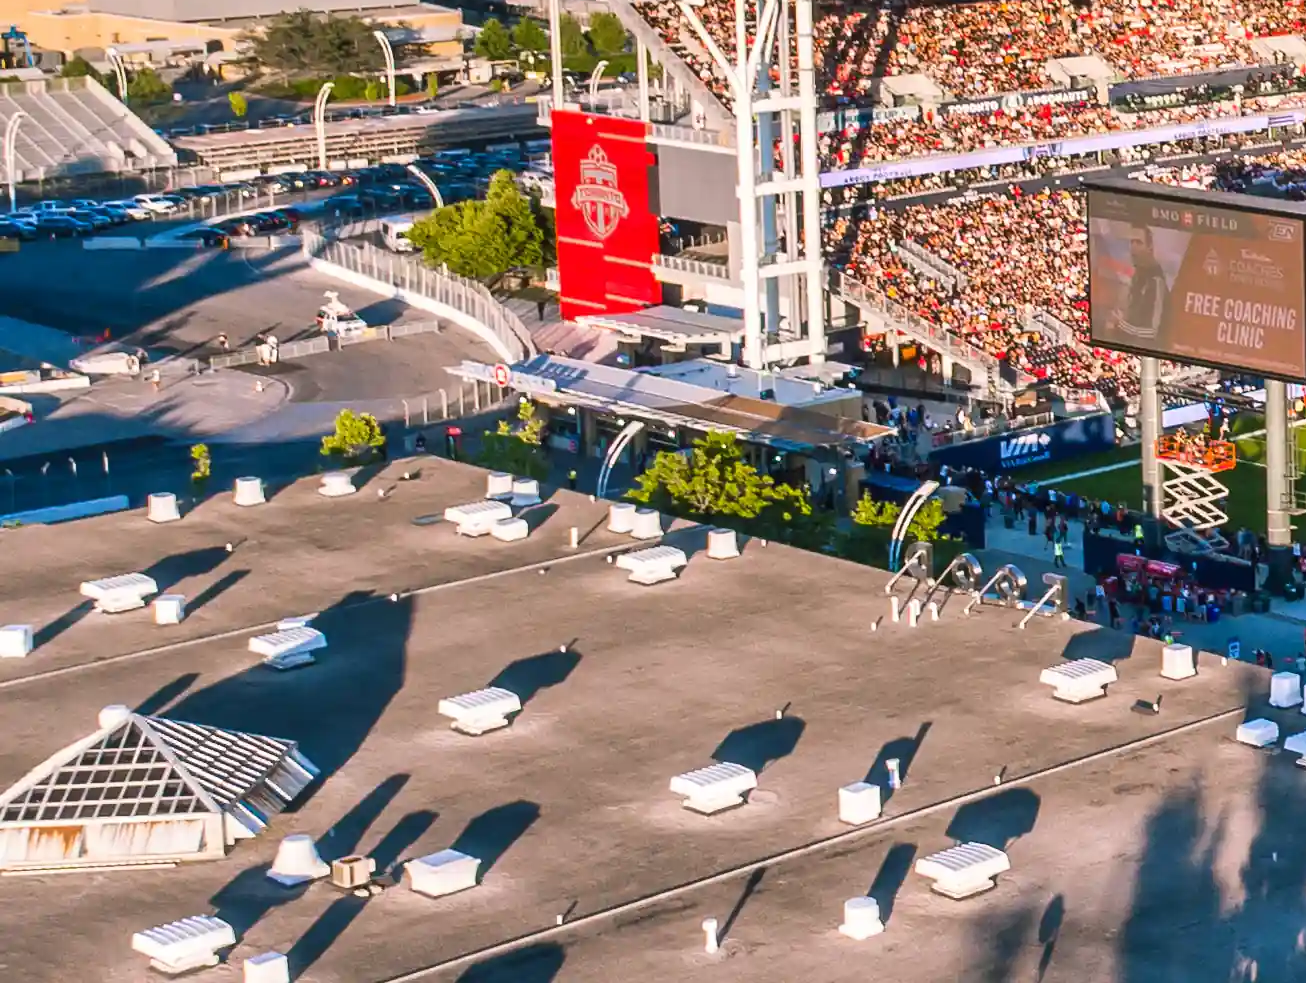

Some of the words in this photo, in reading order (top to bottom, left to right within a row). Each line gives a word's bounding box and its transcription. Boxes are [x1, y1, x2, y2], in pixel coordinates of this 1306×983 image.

[1197, 214, 1239, 231] FIELD
[1184, 291, 1221, 317] FREE
[1223, 298, 1297, 331] COACHING
[1217, 321, 1265, 349] CLINIC
